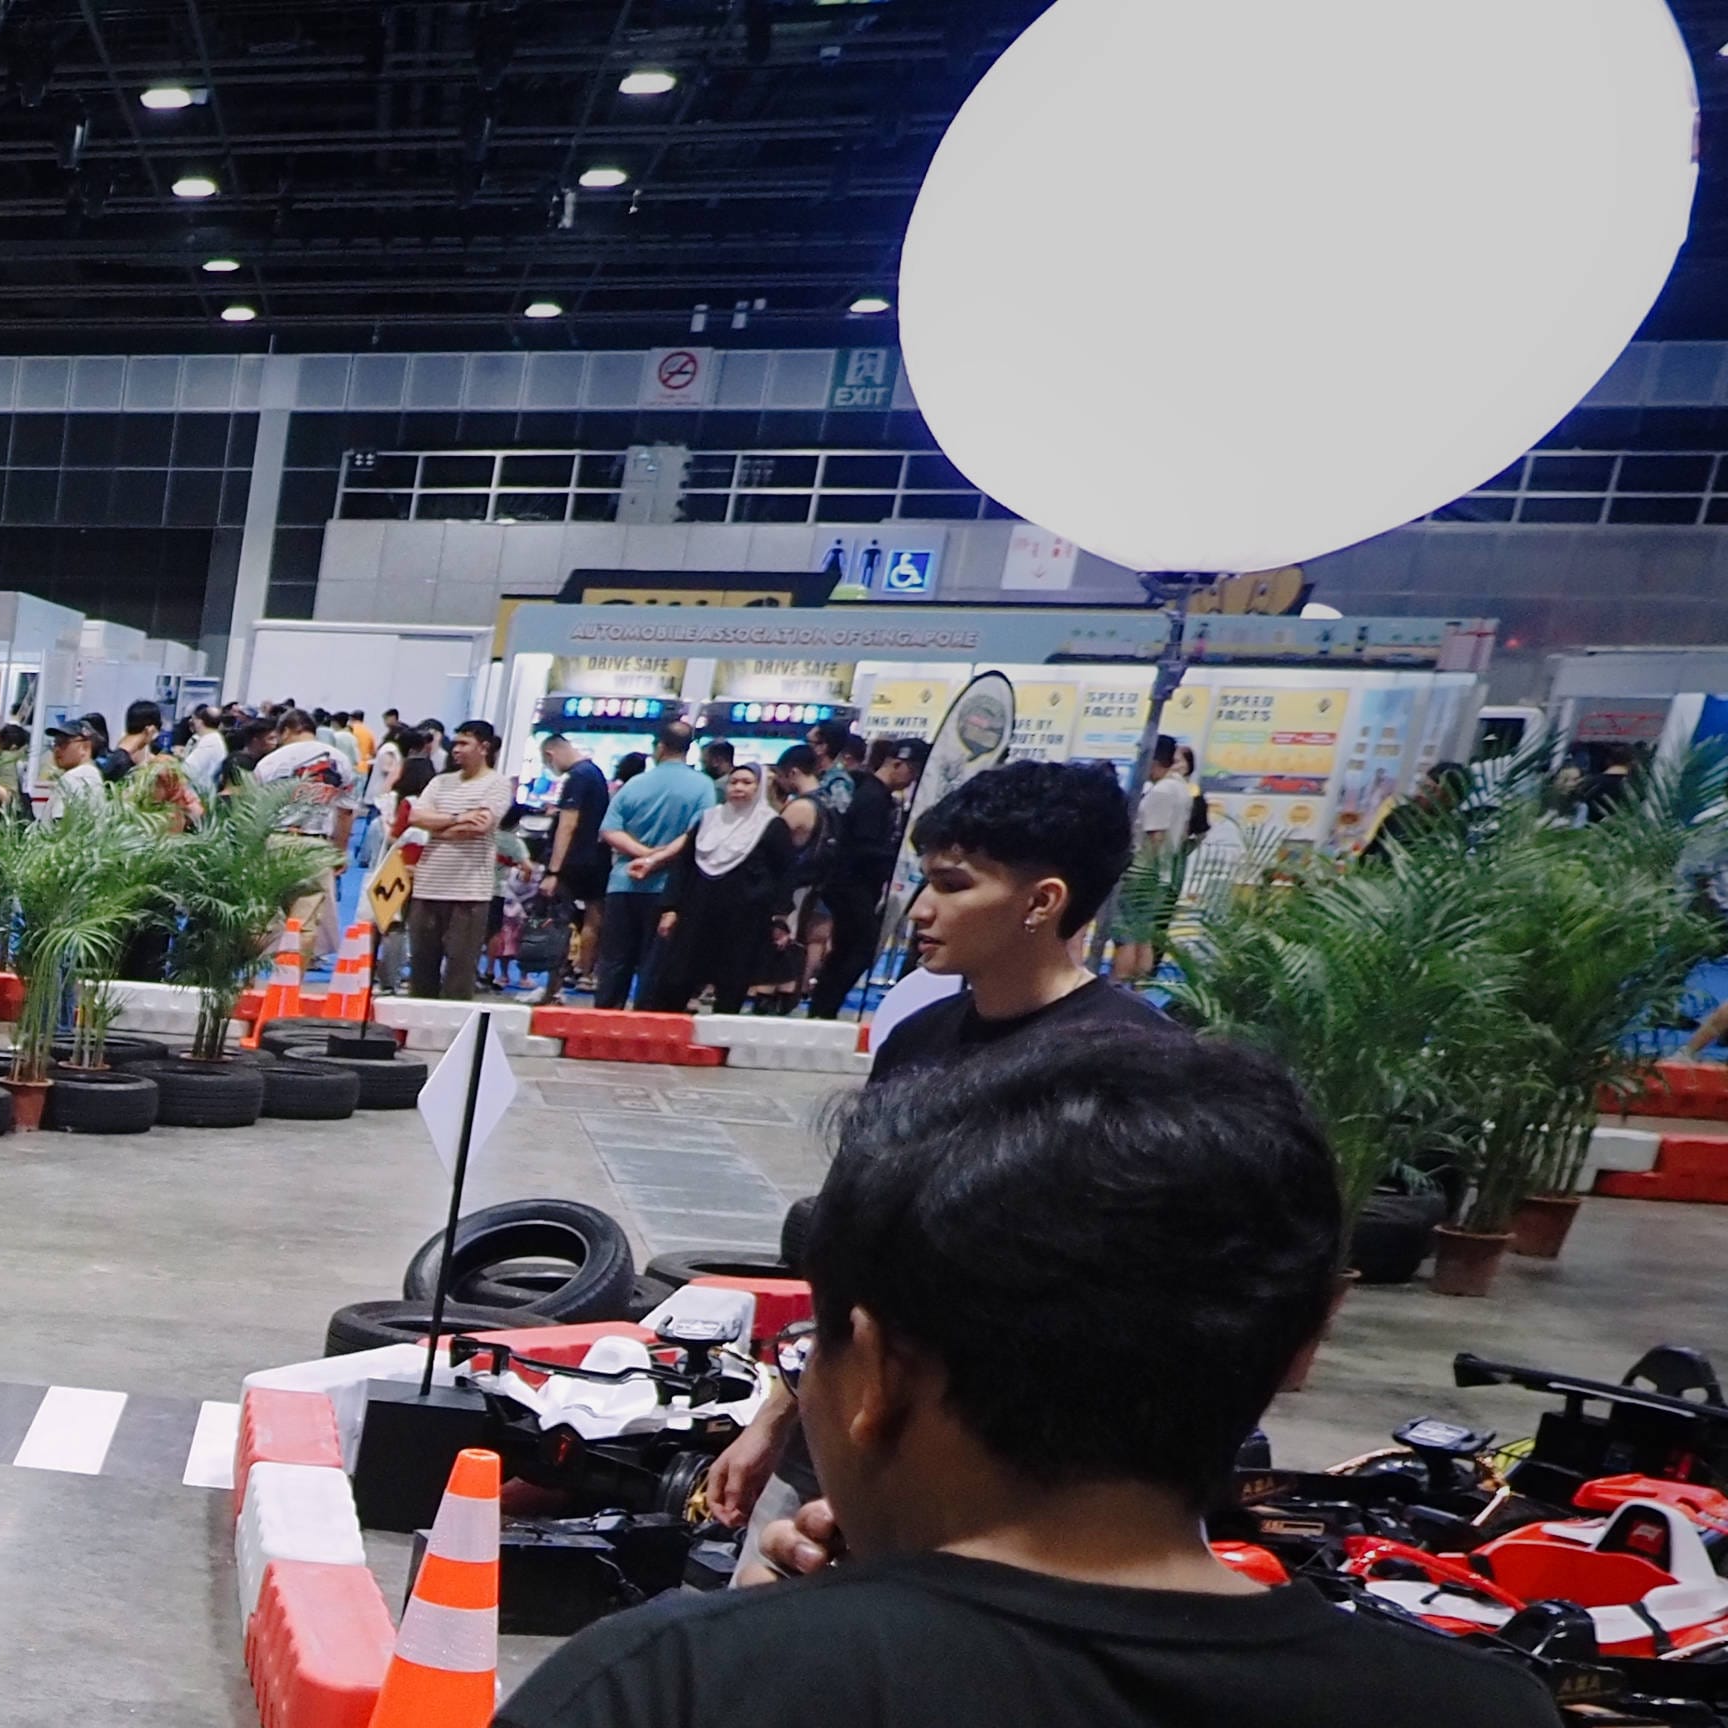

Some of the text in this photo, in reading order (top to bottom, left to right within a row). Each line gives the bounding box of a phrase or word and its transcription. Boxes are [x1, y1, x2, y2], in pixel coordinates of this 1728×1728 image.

[835, 386, 889, 406] EXIT
[571, 622, 978, 649] AUTOMOBILE ASSOCIATION OF SINGAPORE
[588, 656, 669, 673] DRIVE SAFE
[754, 659, 837, 677] DRIVE SAFE
[1084, 706, 1137, 719] FACTS
[1216, 709, 1272, 722] FACTS
